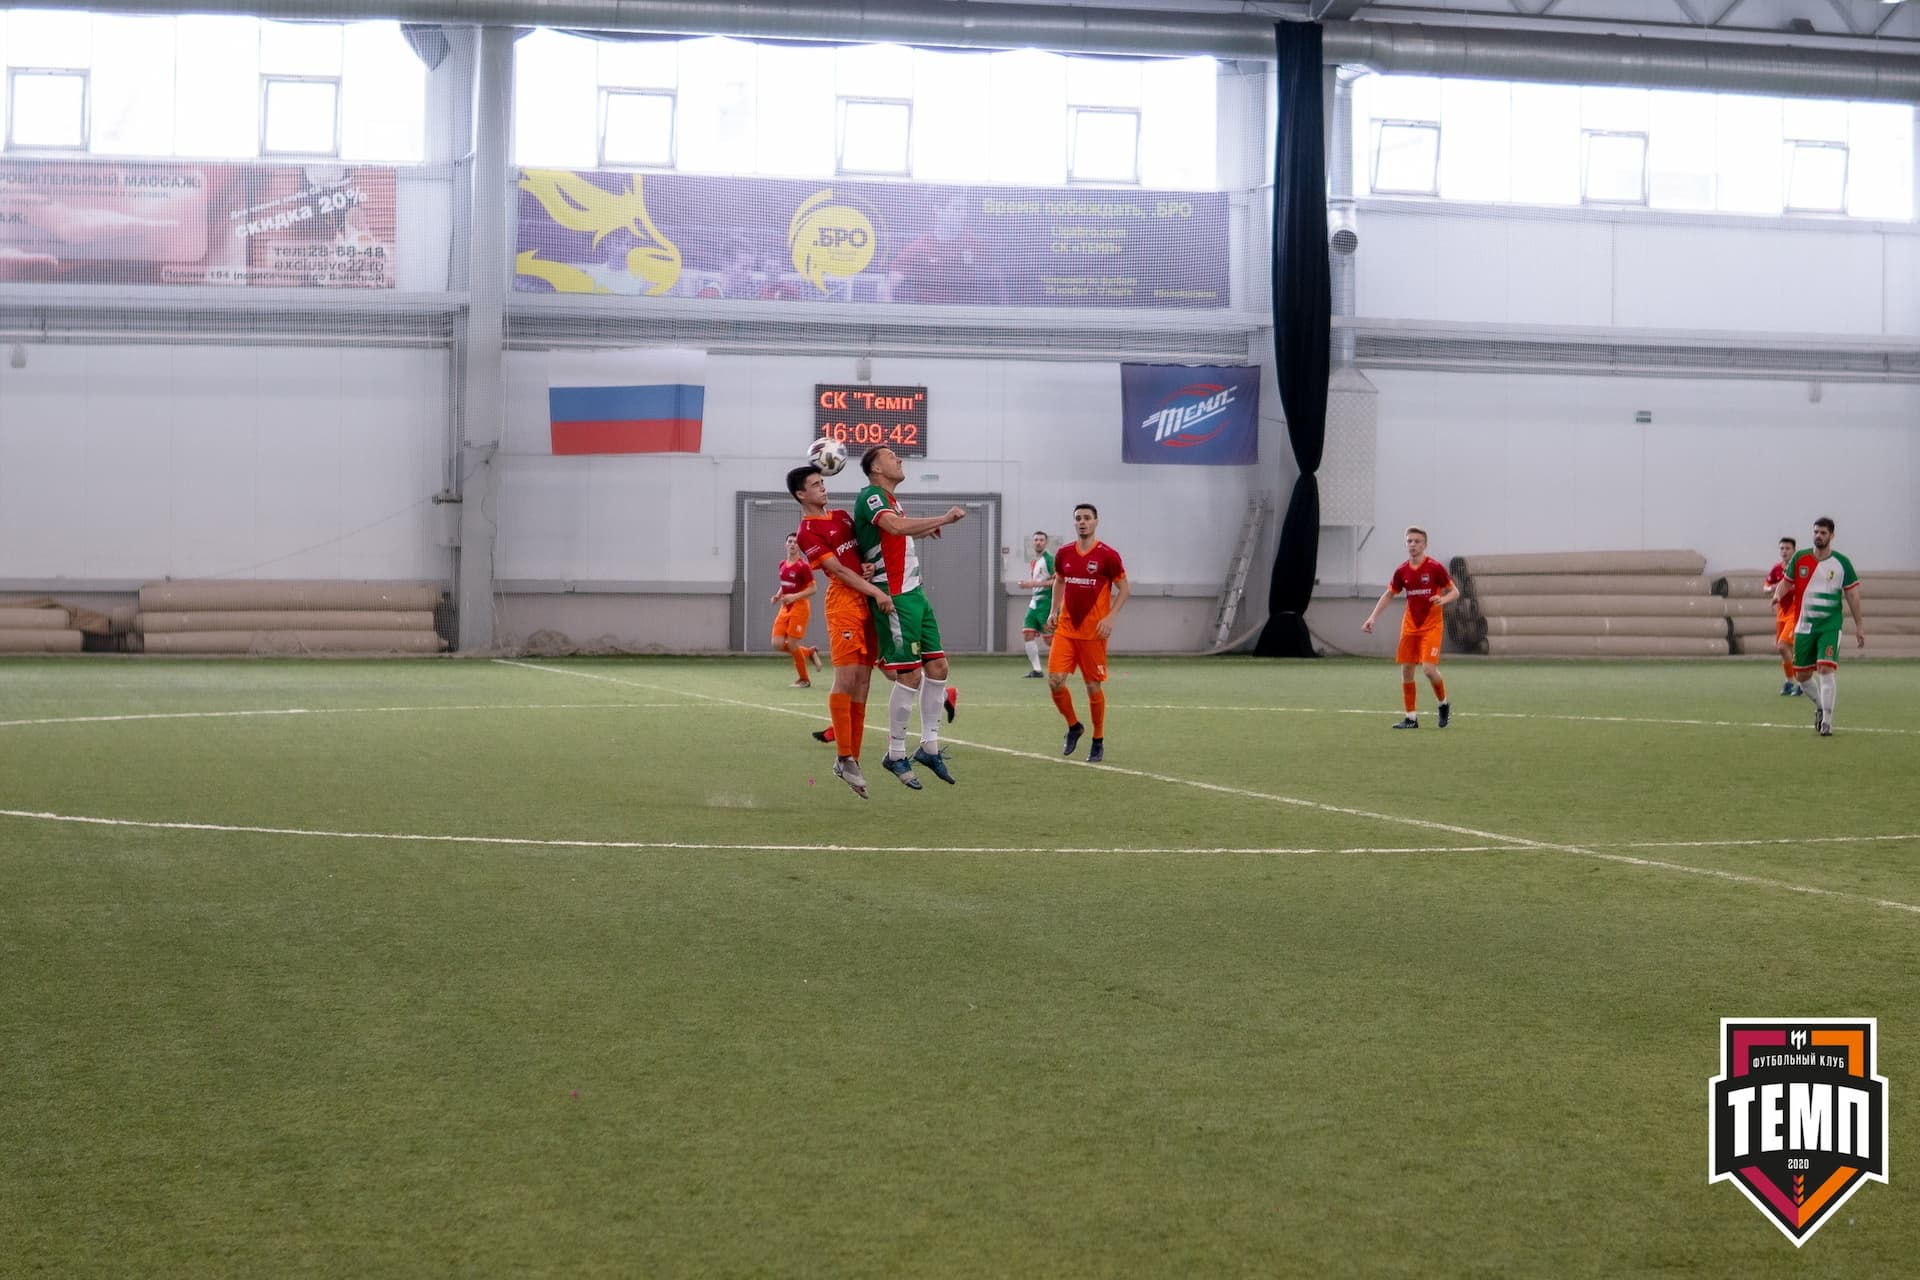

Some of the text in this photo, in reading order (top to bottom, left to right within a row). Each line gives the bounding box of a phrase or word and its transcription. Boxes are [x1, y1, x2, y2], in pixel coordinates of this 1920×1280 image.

[318, 186, 367, 214] 20%
[812, 227, 868, 248] .БРО
[820, 391, 924, 410] СК "Темп"
[821, 422, 918, 445] 16:09:42
